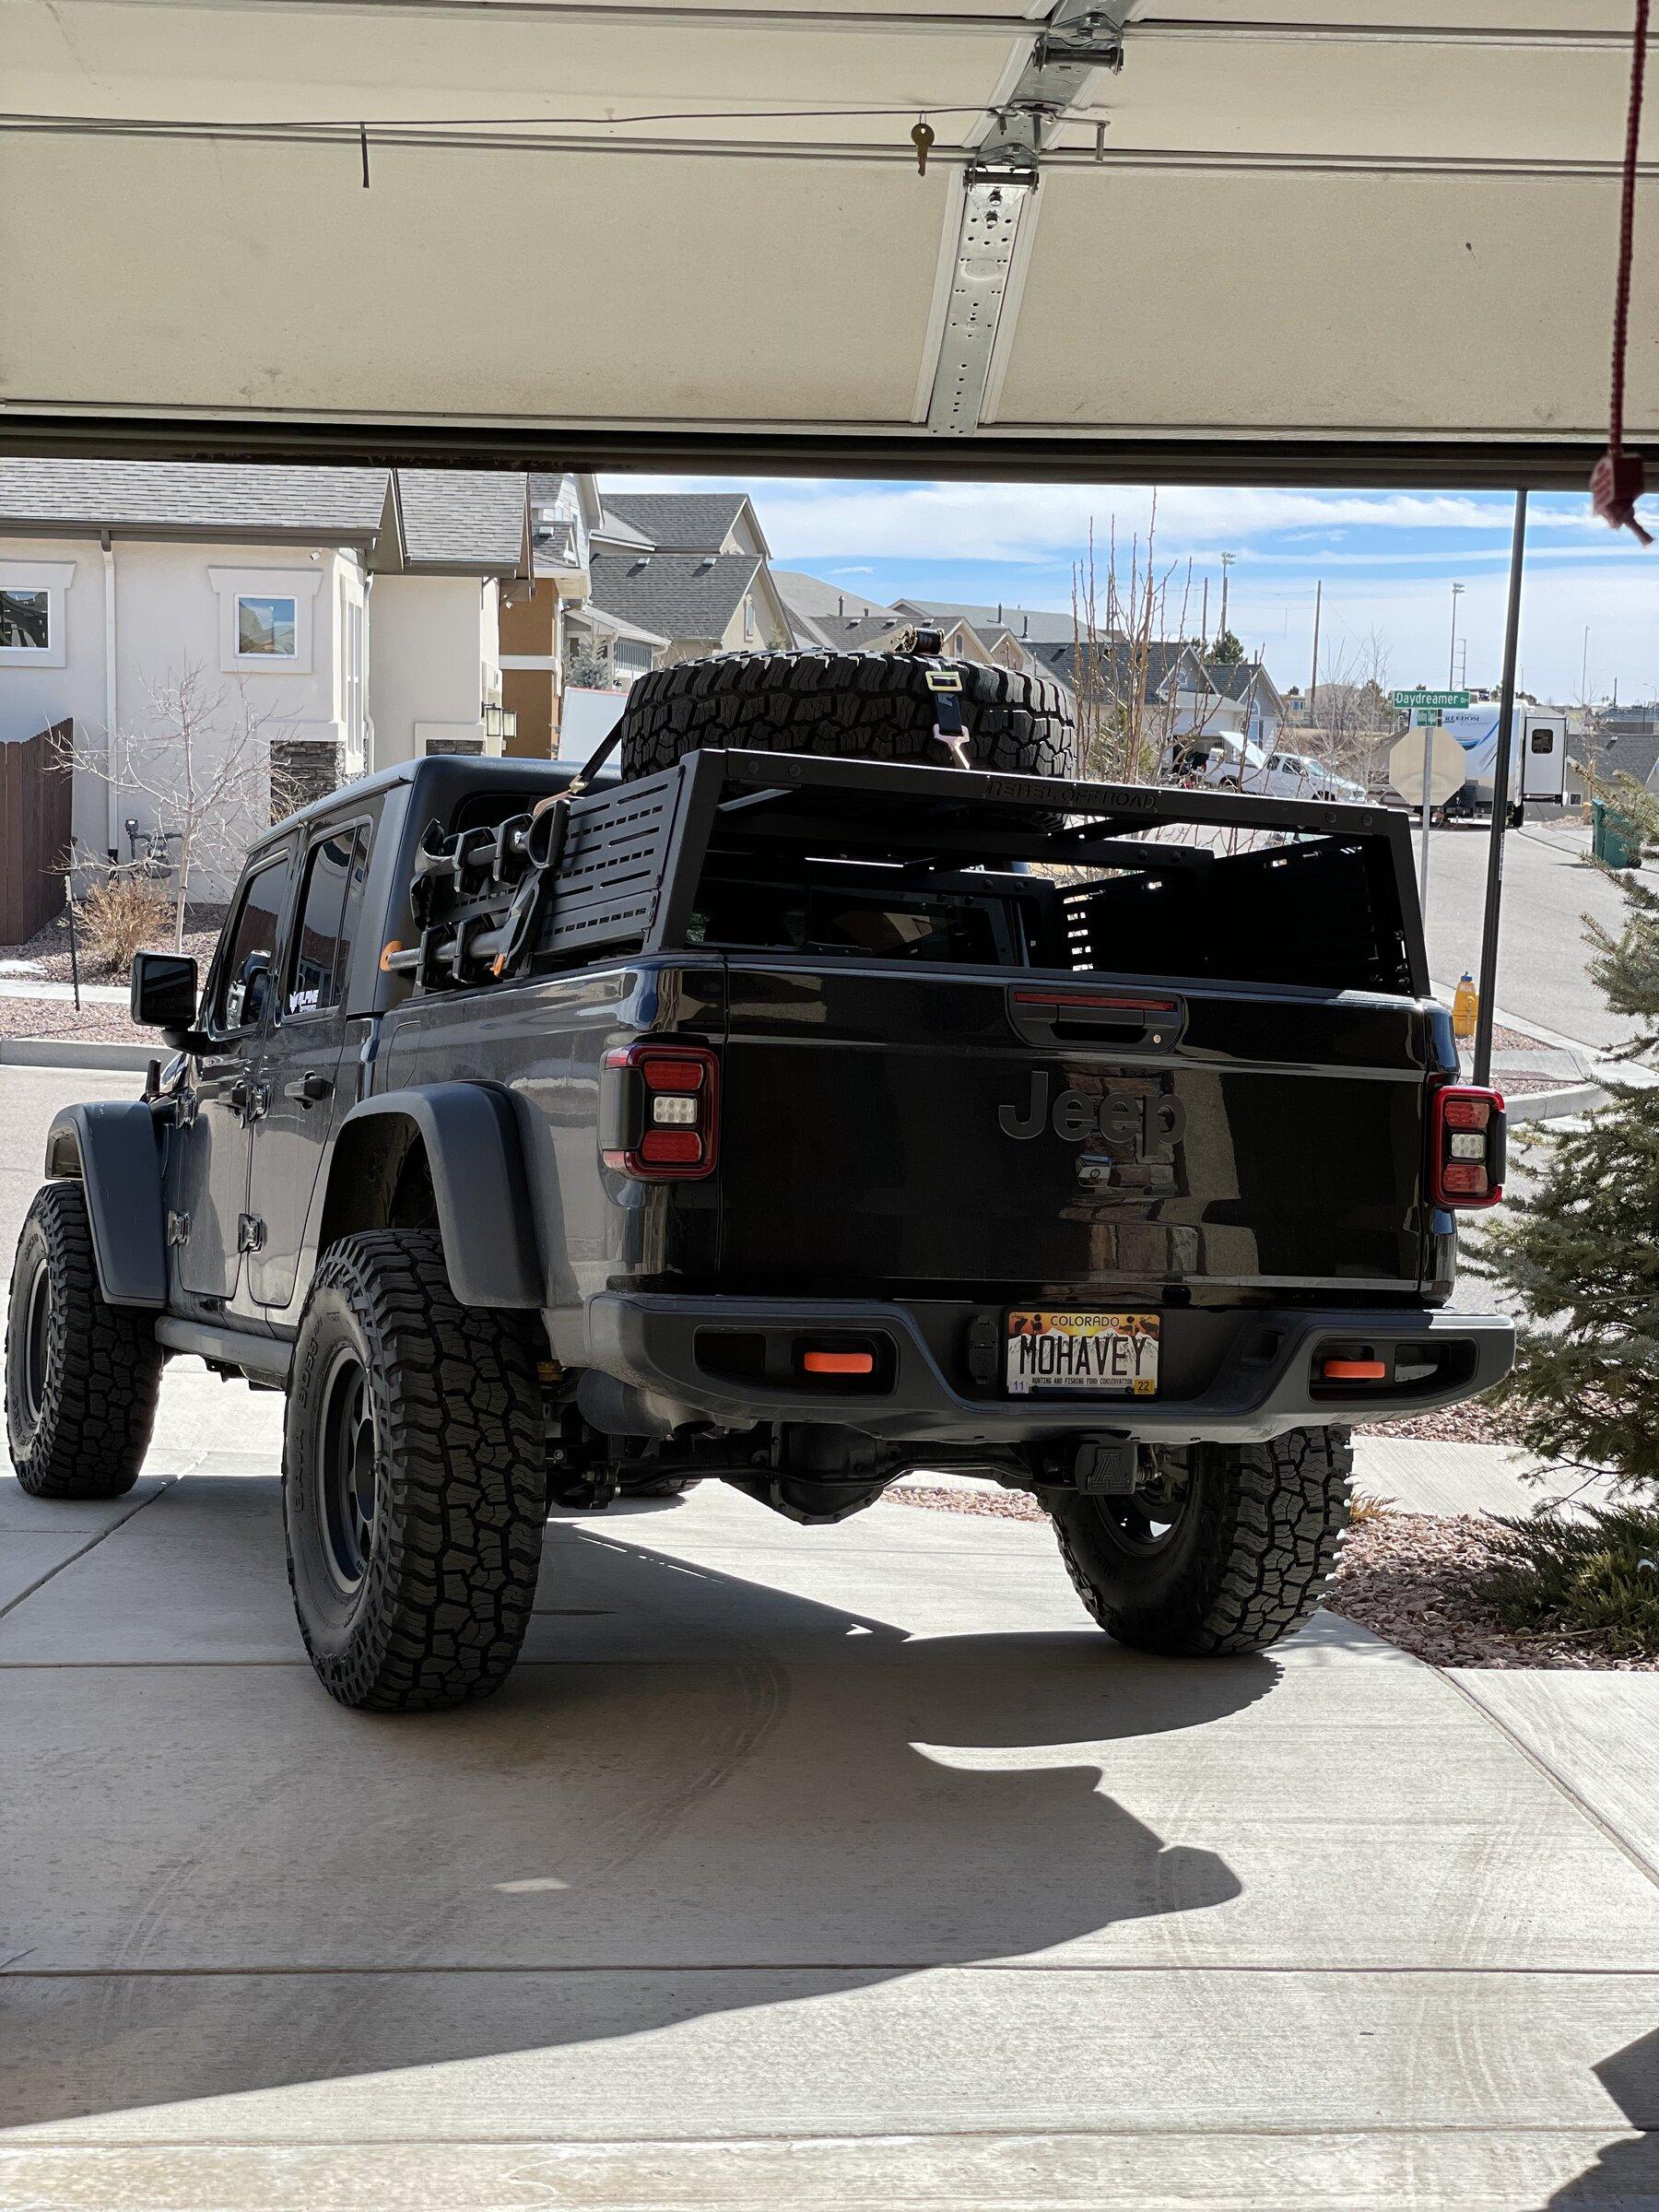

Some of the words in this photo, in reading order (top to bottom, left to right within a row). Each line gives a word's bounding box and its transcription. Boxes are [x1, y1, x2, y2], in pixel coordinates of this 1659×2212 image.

[1395, 691, 1458, 706] Daydreamer
[1443, 714, 1480, 723] REEDOM
[998, 1070, 1187, 1157] Jeep
[1050, 1315, 1120, 1328] COLORADO
[1019, 1335, 1147, 1376] MOHAVEY
[1013, 1381, 1025, 1391] 11
[1137, 1381, 1150, 1391] 22
